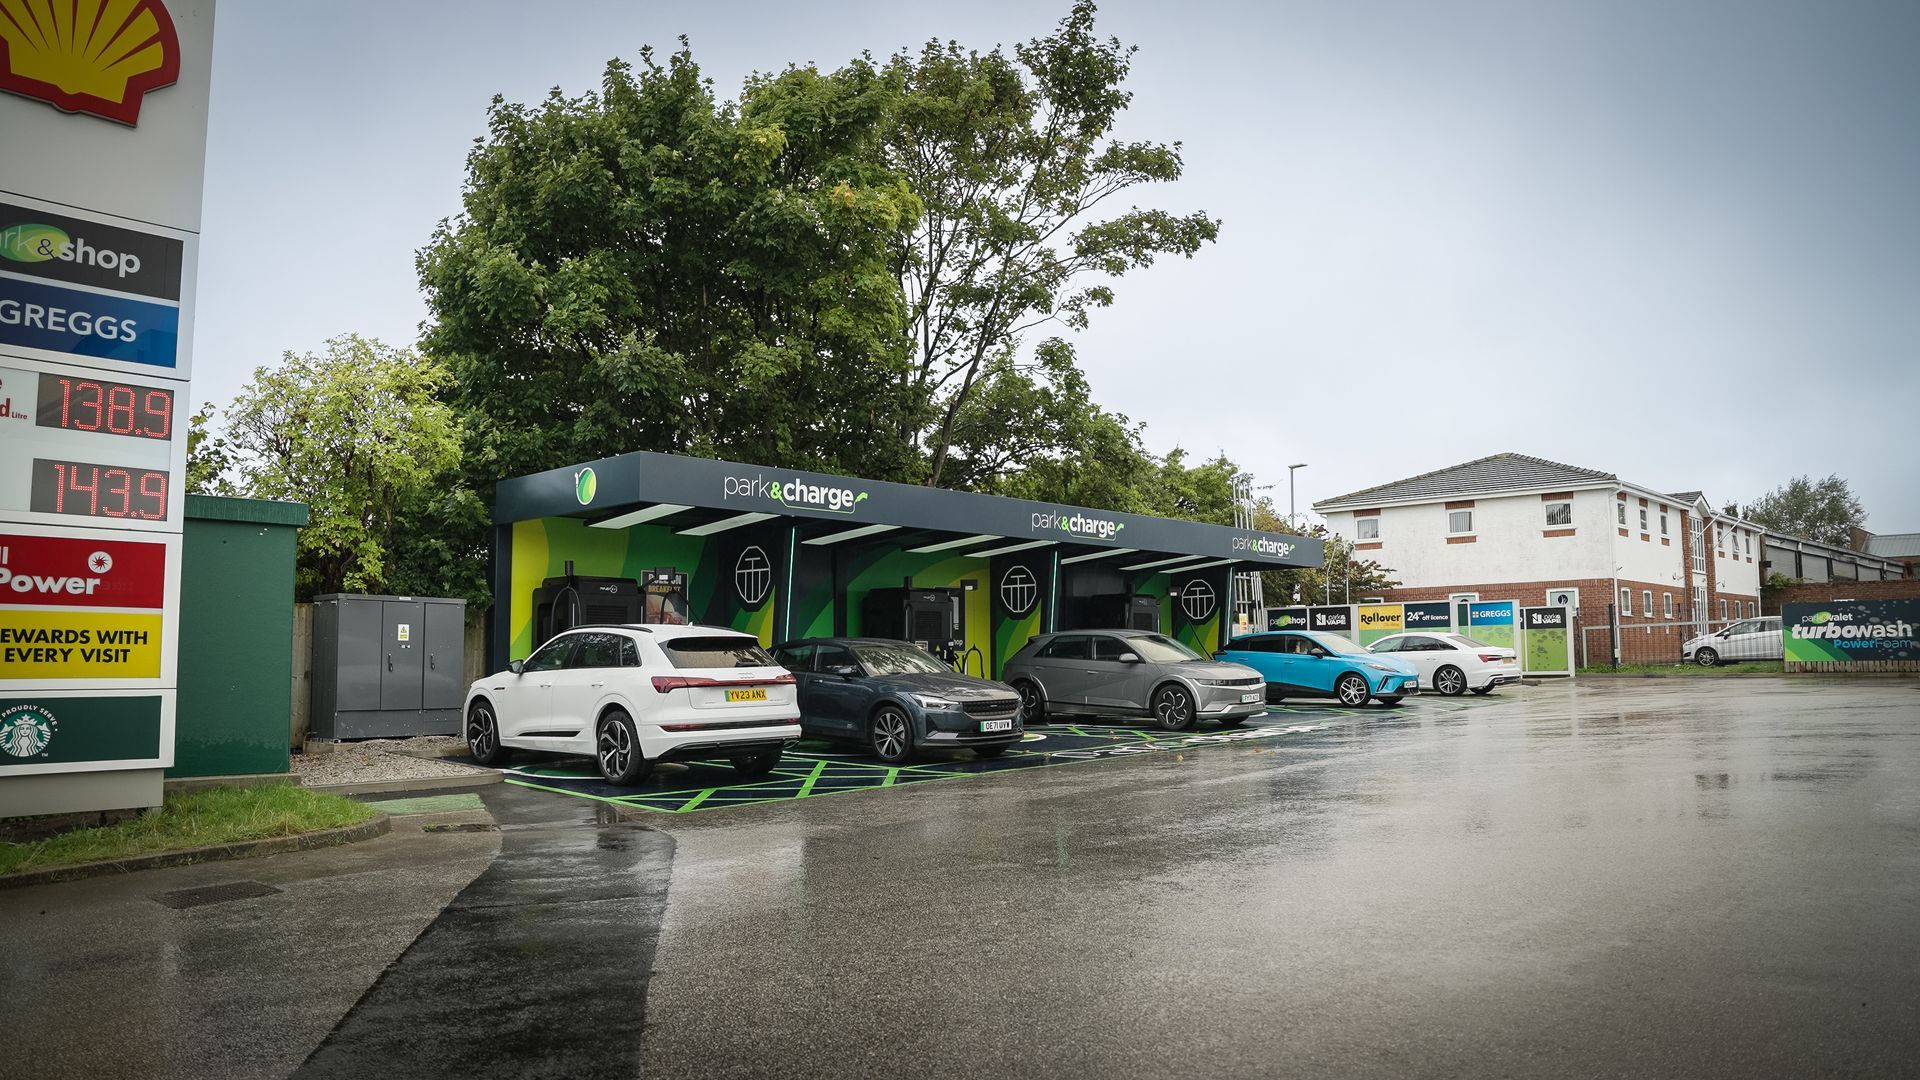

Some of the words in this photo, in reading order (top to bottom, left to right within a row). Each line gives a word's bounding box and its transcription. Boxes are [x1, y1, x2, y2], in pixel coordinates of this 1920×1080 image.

[0, 299, 137, 343] GREGGS
[11, 412, 28, 420] Litre
[60, 379, 171, 438] 138.9
[54, 464, 168, 520] 143.9
[724, 474, 854, 510] park&charge
[1031, 510, 1116, 538] park&charge
[1232, 534, 1289, 557] park&charge
[1360, 612, 1401, 625] Rollover
[1480, 609, 1511, 618] GREGGS
[0, 628, 91, 644] EWARDS
[97, 630, 148, 645] WITH
[1791, 620, 1913, 639] turbowash
[1833, 639, 1913, 649] PowerFoam
[4, 647, 74, 663] EVERY
[80, 648, 131, 663] VISIT
[730, 690, 750, 700] YV23
[752, 689, 766, 699] ANX
[1, 704, 38, 718] PROUDLY
[39, 708, 58, 726] SERVE
